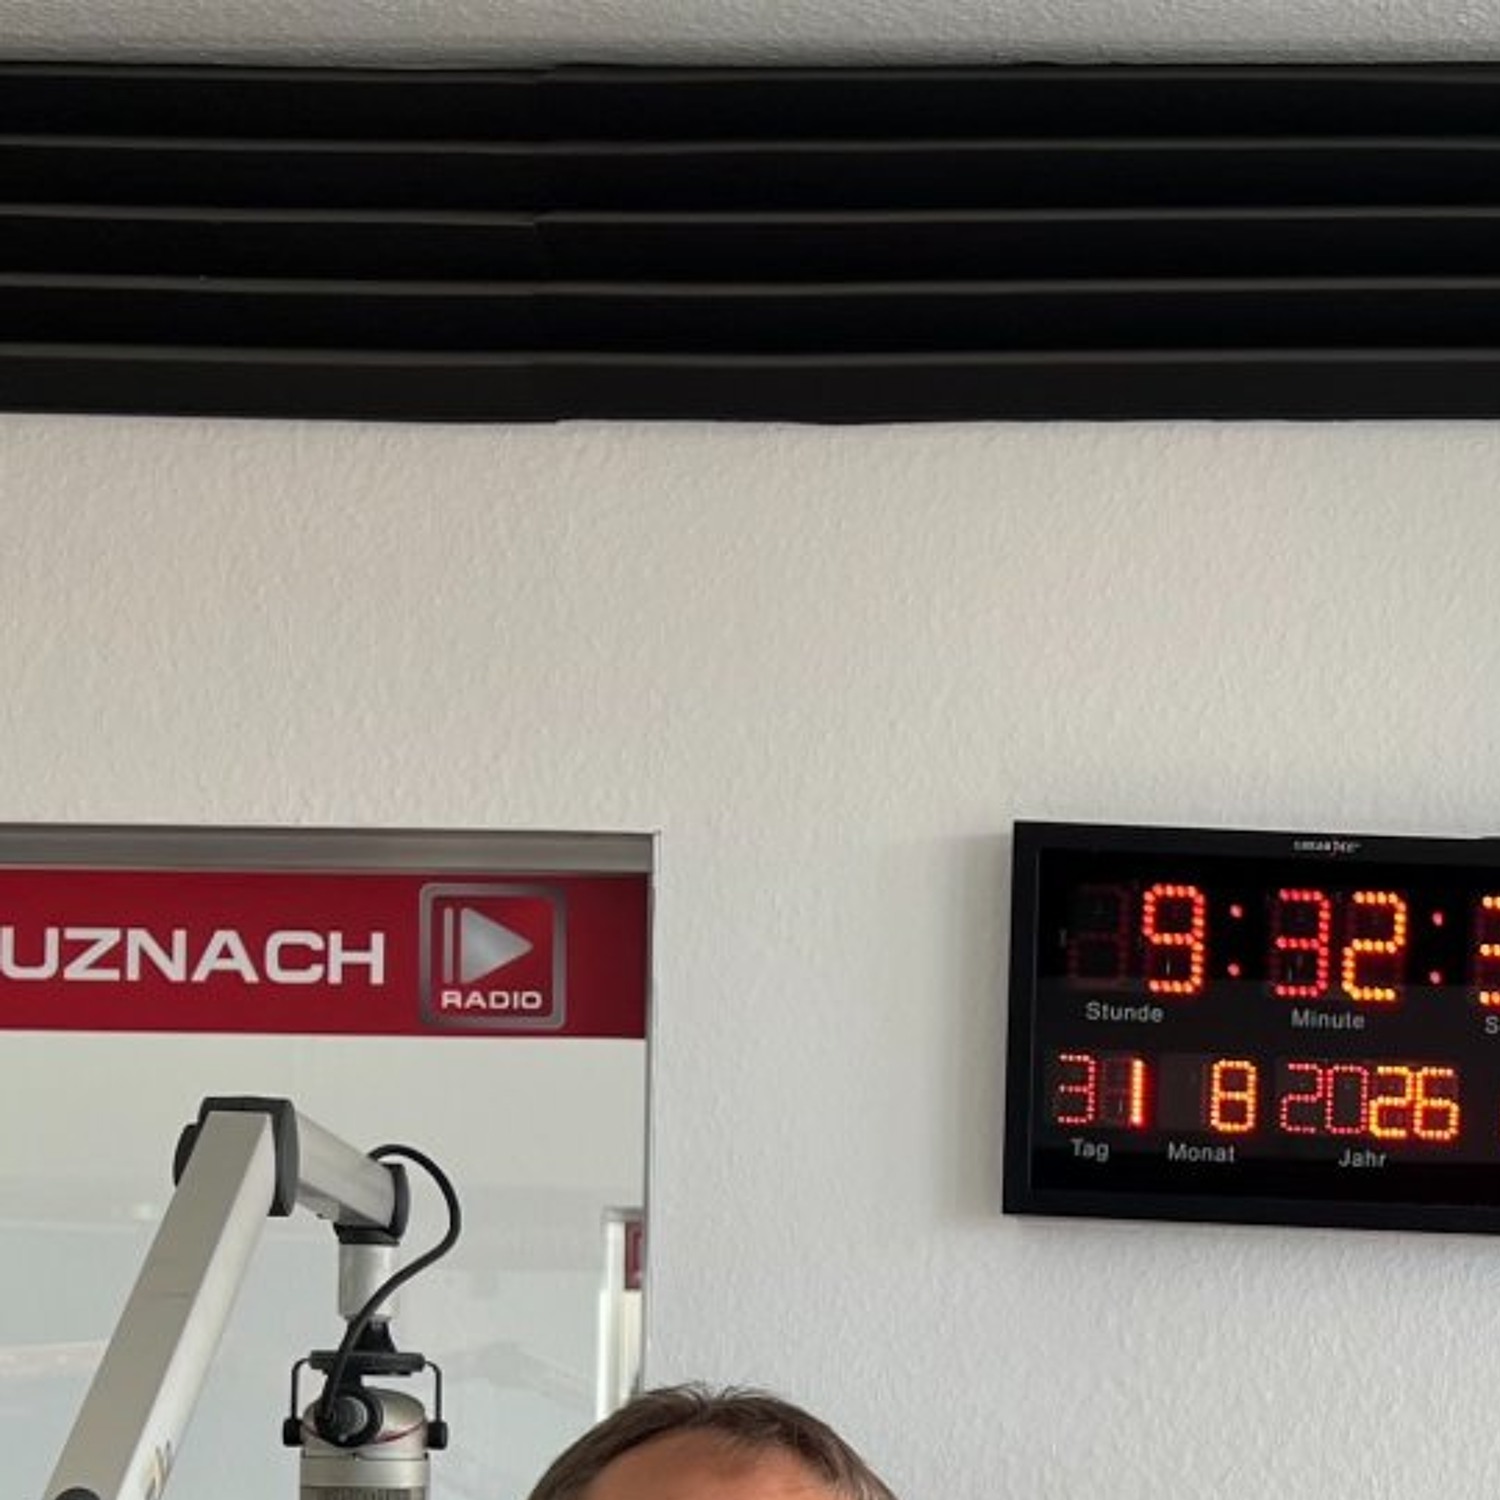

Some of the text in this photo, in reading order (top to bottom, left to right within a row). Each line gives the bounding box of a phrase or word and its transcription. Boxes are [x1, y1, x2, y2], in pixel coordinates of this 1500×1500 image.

[0, 926, 385, 985] UZNACH
[441, 989, 542, 1010] RADIO
[1085, 1001, 1165, 1024] Stunde
[1291, 1008, 1366, 1030] Minute
[1057, 1052, 1146, 1127] 31
[1209, 1058, 1258, 1132] 8
[1279, 1061, 1461, 1140] 2026
[1071, 1138, 1110, 1161] Tag
[1168, 1141, 1236, 1162] Monat
[1338, 1148, 1388, 1169] Jahr
